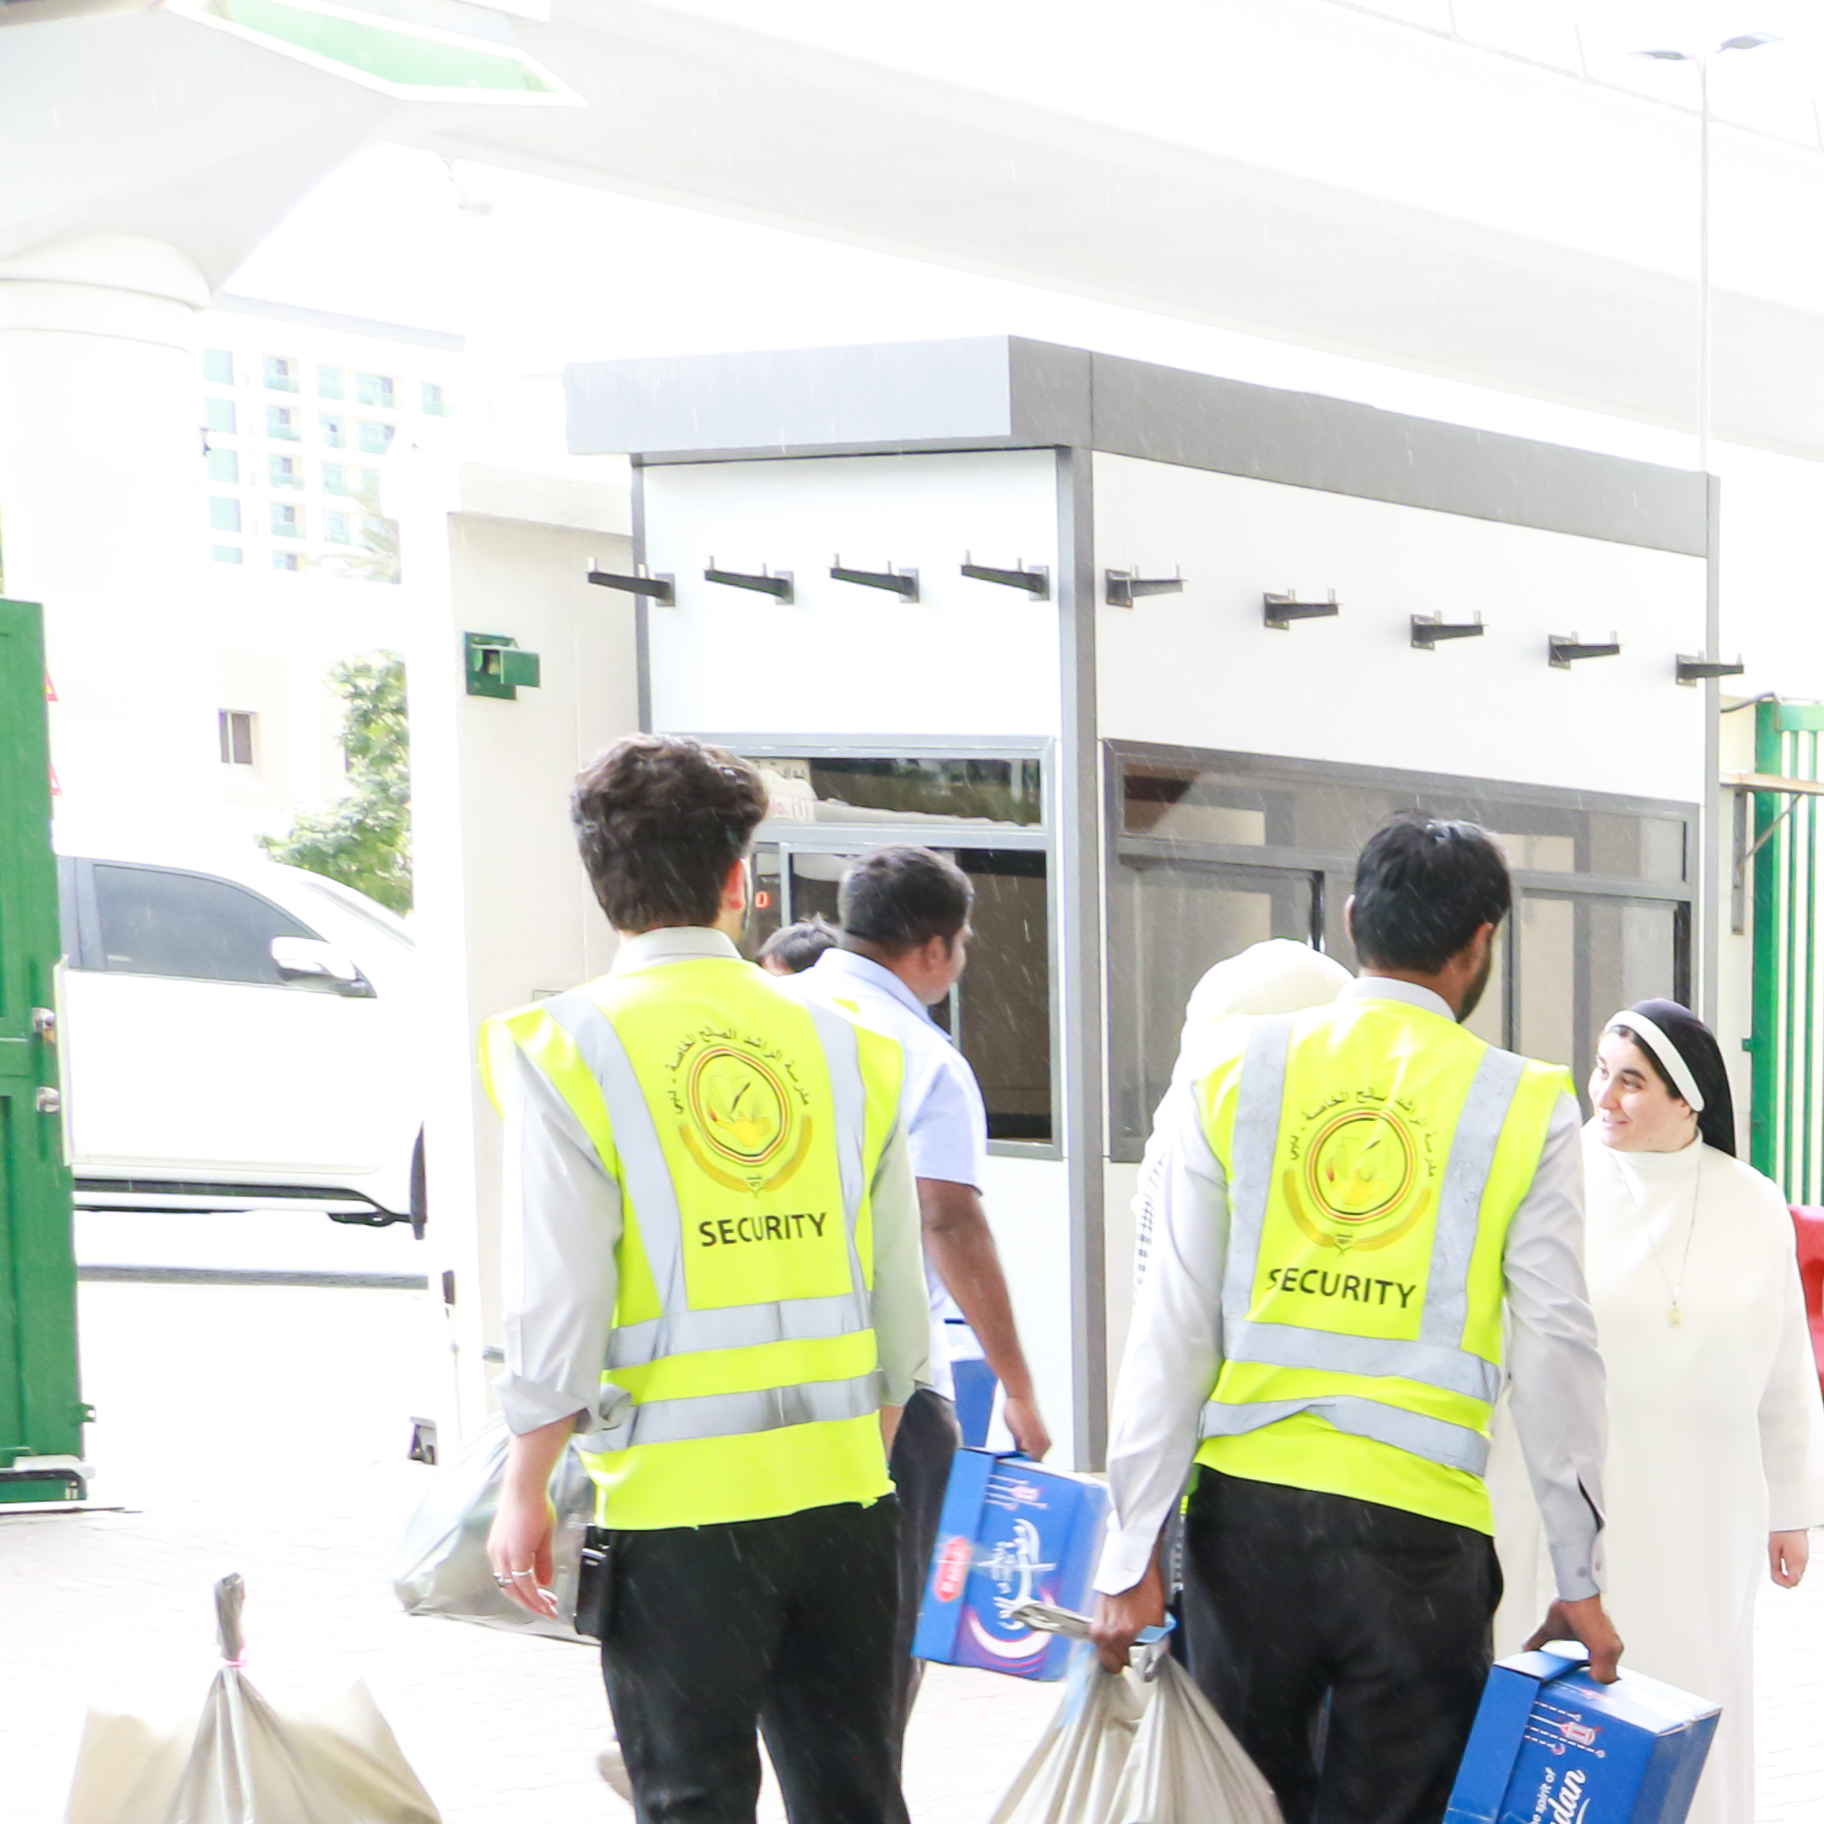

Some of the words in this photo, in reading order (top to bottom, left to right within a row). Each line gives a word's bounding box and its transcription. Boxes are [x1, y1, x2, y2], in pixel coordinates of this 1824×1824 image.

[698, 1212, 827, 1247] SECURITY
[1266, 1267, 1417, 1309] SECURITY
[1544, 1767, 1556, 1783] of
[1536, 1783, 1553, 1814] spirit
